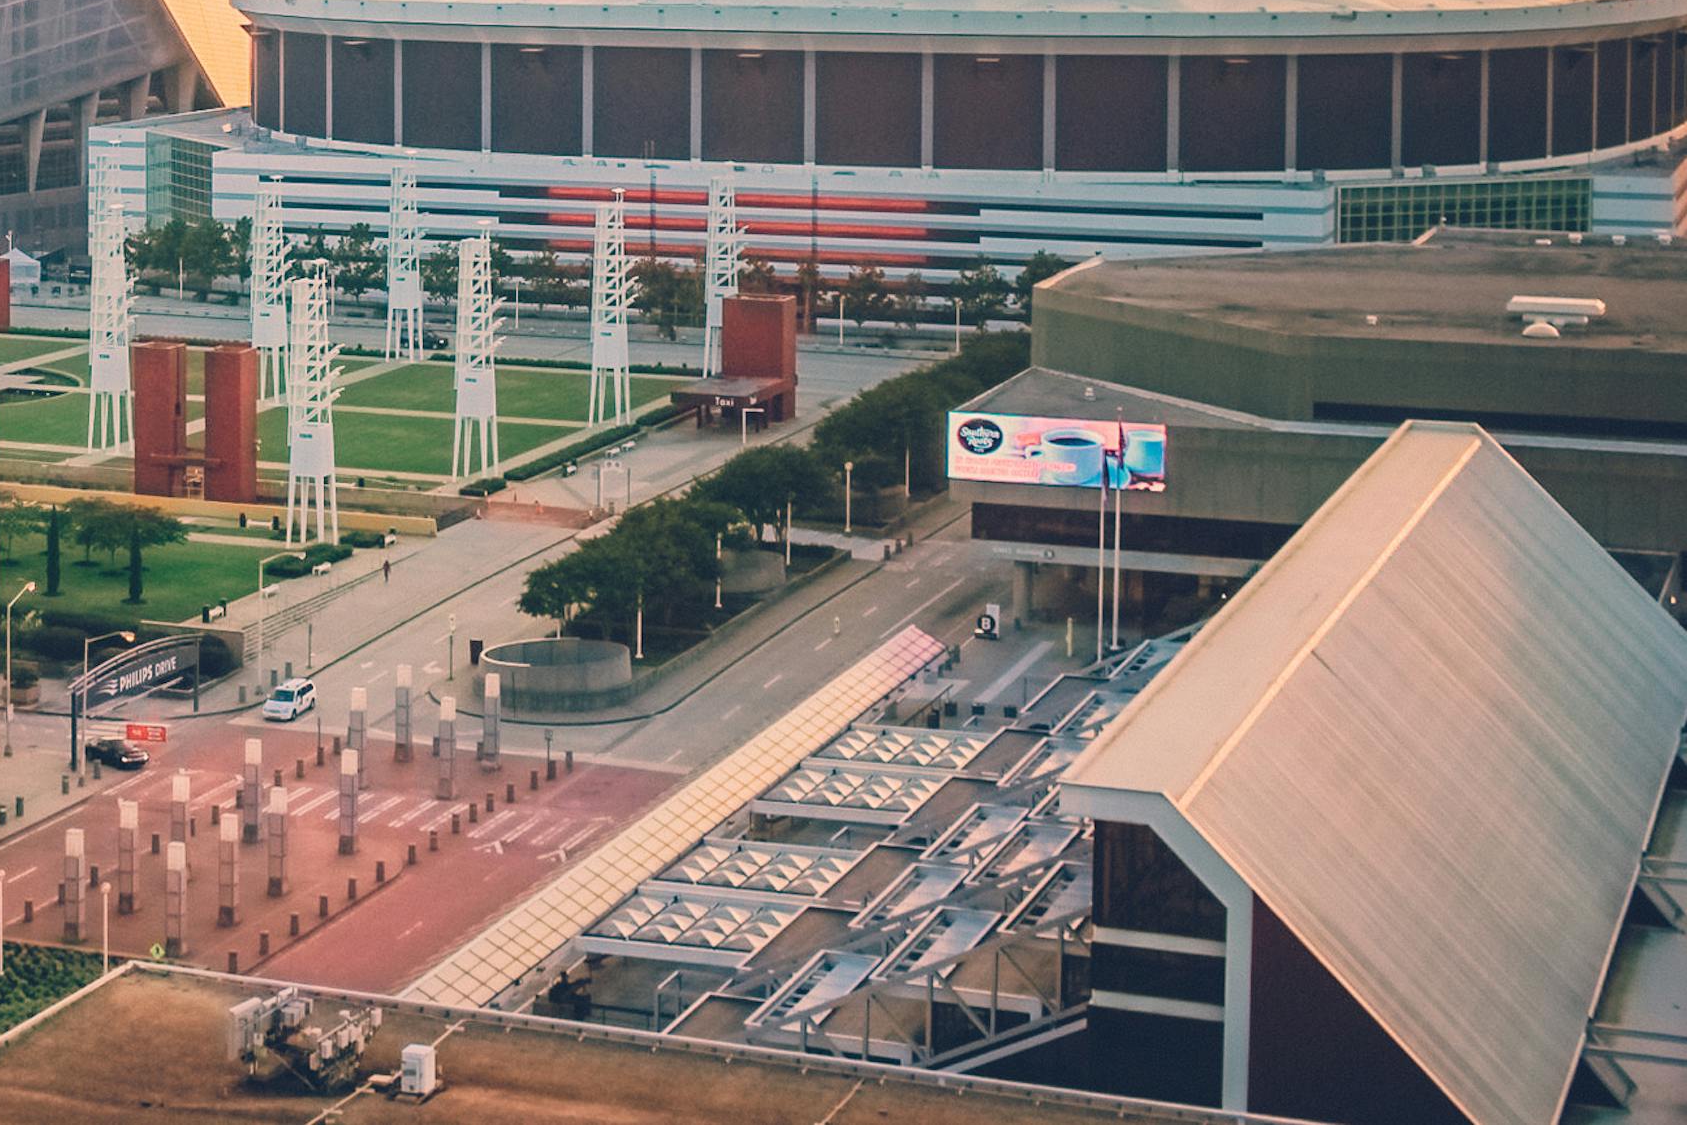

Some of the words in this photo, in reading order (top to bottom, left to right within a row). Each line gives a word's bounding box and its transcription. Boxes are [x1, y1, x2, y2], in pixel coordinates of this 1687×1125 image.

[715, 396, 734, 407] Taxi
[960, 426, 1001, 440] Southern
[981, 617, 991, 630] B
[119, 664, 153, 692] PHILIPS
[155, 656, 177, 676] DRIVE
